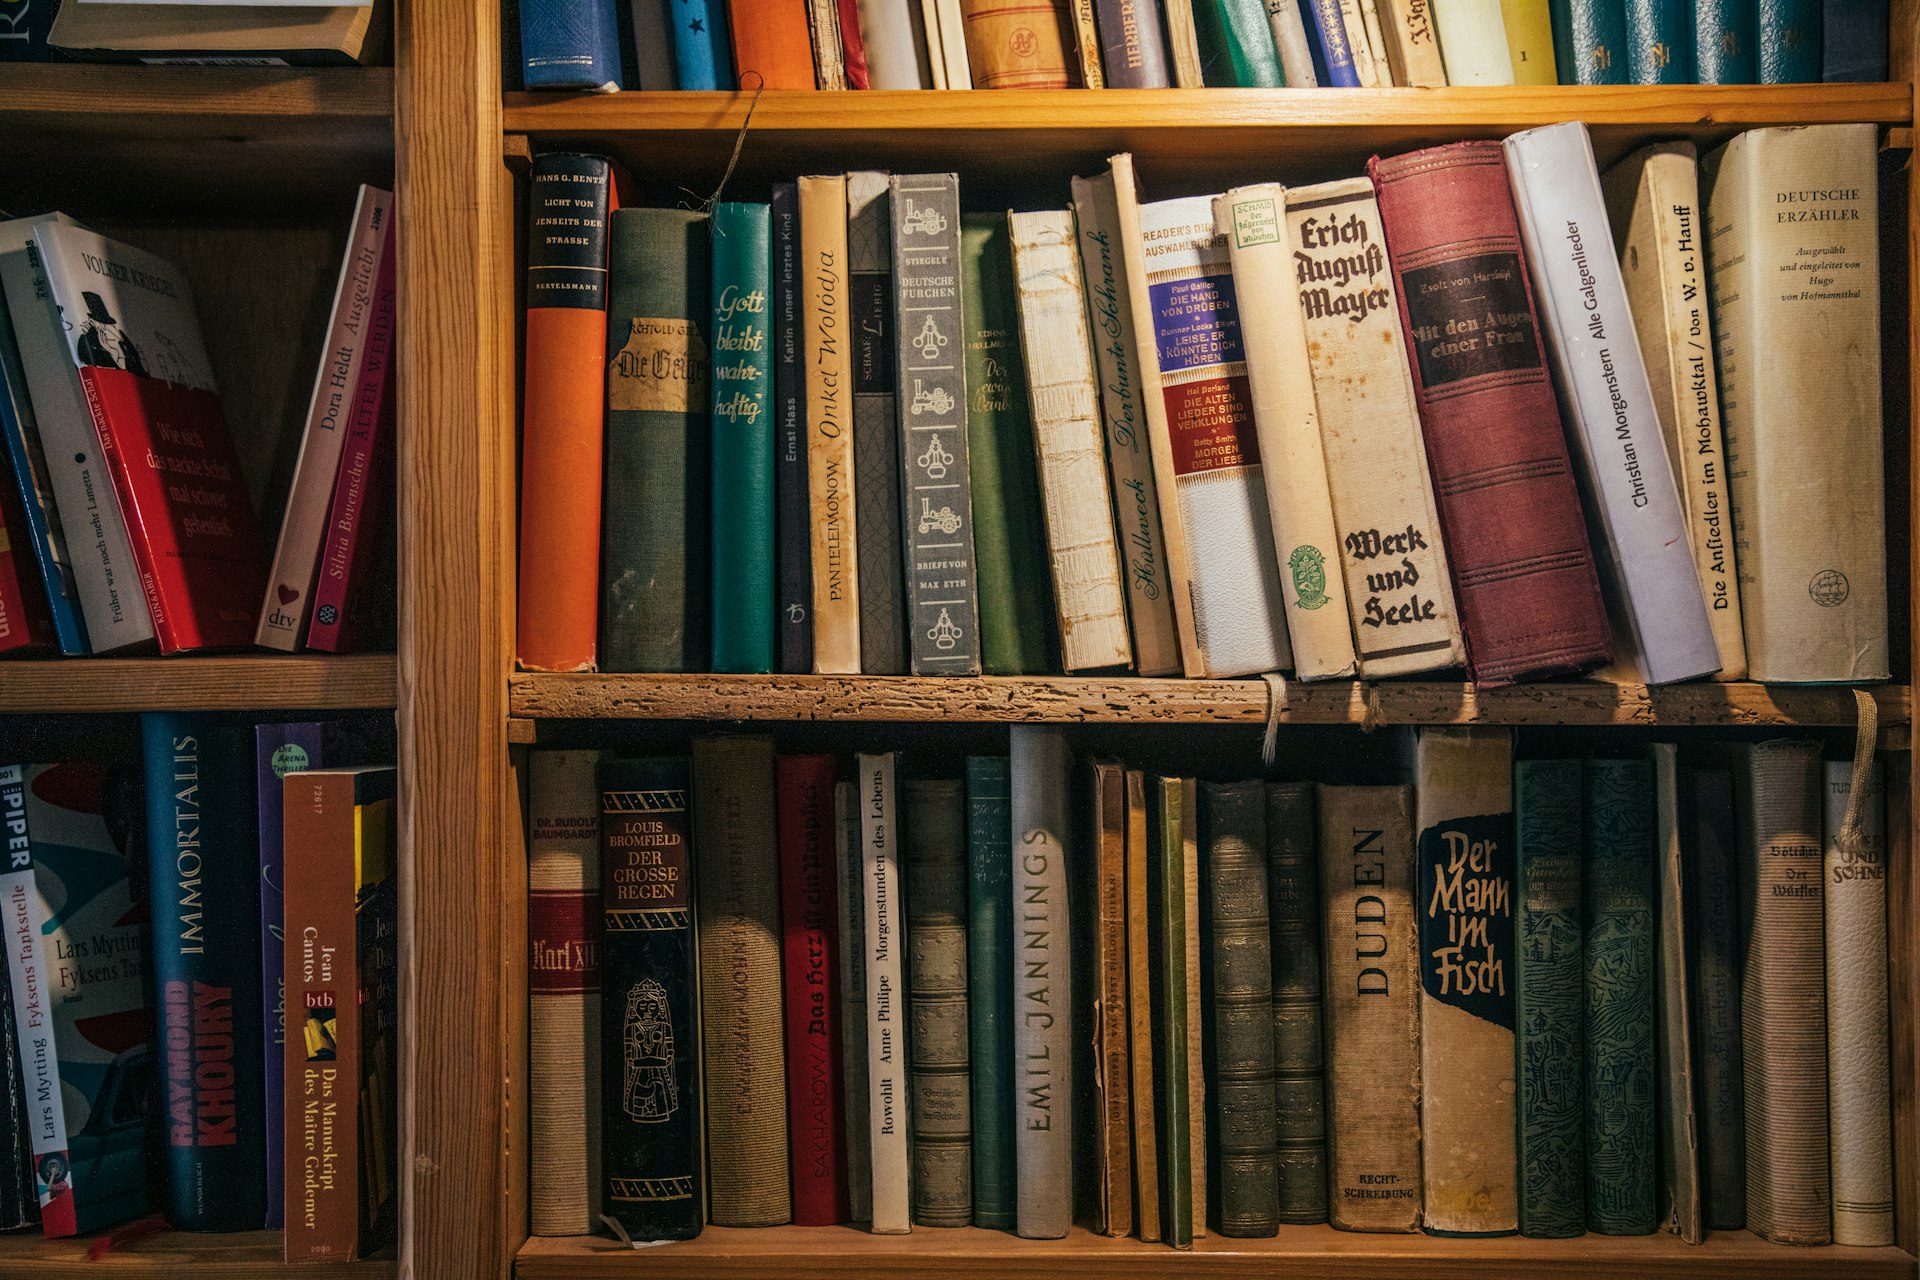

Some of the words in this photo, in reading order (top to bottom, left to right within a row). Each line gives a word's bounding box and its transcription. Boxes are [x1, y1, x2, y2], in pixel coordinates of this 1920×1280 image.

[572, 176, 605, 185] BENTZ
[544, 199, 572, 207] LICHT
[574, 199, 594, 208] VON
[1237, 201, 1273, 214] SCHMID
[1776, 189, 1861, 203] DEUTSCHE
[535, 218, 580, 227] JENSEITS
[583, 219, 603, 228] DER
[781, 213, 793, 244] Kind
[1300, 211, 1370, 250] Erich
[1673, 204, 1694, 252] Hauff
[1777, 209, 1861, 223] ERZÄHLER
[546, 236, 589, 246] STRASSE
[1143, 224, 1192, 243] READER'S
[26, 239, 40, 269] 23588
[782, 243, 793, 284] letztes
[904, 256, 948, 265] STIEGELE
[1294, 242, 1384, 288] August
[1566, 219, 1599, 312] Galgenlieder
[1779, 263, 1797, 272] und
[1799, 262, 1843, 272] eingeleitet
[1844, 261, 1861, 269] von
[1795, 246, 1846, 258] Ausgewählt
[82, 252, 131, 283] VOLKER
[902, 276, 954, 287] DEUTSCHE
[1809, 277, 1834, 287] Hugo
[343, 249, 376, 335] Ausgeliebt
[535, 282, 598, 292] BERTELSMANN
[902, 288, 955, 298] FURCHEN
[1088, 231, 1122, 339] Schrank
[1169, 295, 1189, 306] DIE
[1190, 291, 1220, 304] HAND
[1171, 284, 1190, 294] Paul
[1190, 281, 1215, 291] Gallico
[1420, 281, 1449, 294] Zsolt
[1450, 276, 1471, 288] von
[1682, 278, 1697, 302] W.
[1800, 290, 1861, 301] Hofmannsthal
[784, 287, 793, 326] unser
[1161, 306, 1185, 318] VON
[1300, 286, 1390, 323] Mayer
[368, 288, 395, 372] WERDEN
[715, 324, 764, 353] bleibt
[1160, 326, 1190, 337] Sumner
[1191, 323, 1214, 332] Locke
[1211, 331, 1226, 341] ER
[1411, 323, 1441, 344] Mit
[1445, 317, 1479, 335] den
[1587, 312, 1607, 340] Alle
[783, 327, 795, 364] Katrin
[1166, 344, 1209, 359] KÖNNTE
[1211, 341, 1236, 354] DICH
[1430, 336, 1479, 359] einer
[1484, 330, 1525, 347] Frau
[328, 346, 353, 391] Heldt
[618, 349, 648, 378] Die
[1107, 341, 1133, 401] bunte
[1184, 353, 1223, 366] HÖREN
[817, 369, 842, 439] Onkel
[1183, 396, 1203, 408] DIE
[1204, 393, 1237, 406] ALTEN
[1186, 386, 1201, 396] Hal
[1201, 383, 1231, 395] Borland
[1599, 347, 1632, 440] Morgenstern
[93, 404, 108, 431] nackte
[320, 394, 339, 433] Dora
[784, 397, 797, 433] Hass
[1177, 407, 1216, 421] LIEDER
[1218, 402, 1245, 415] SIND
[1688, 356, 1715, 456] Mohawktal
[156, 421, 181, 445] Wie
[1112, 402, 1140, 454] Der
[1176, 412, 1248, 431] VERKLUNGEN
[102, 430, 113, 450] Das
[785, 436, 797, 463] Ernst
[1193, 438, 1217, 448] Betty
[1216, 434, 1238, 445] Smith
[1194, 444, 1240, 459] MORGEN
[146, 447, 167, 471] das
[1191, 459, 1214, 470] DER
[1215, 454, 1245, 467] LIEBE
[1702, 460, 1714, 485] im
[1623, 441, 1648, 509] Christian
[83, 469, 98, 512] Lametta
[338, 450, 366, 537] Bovenschen
[89, 513, 105, 539] mehr
[827, 459, 842, 602] PANTELEIMONOW
[97, 539, 111, 566] noch
[1344, 524, 1429, 562] Werk
[329, 538, 348, 580] Silvia
[916, 560, 947, 571] BRIEFE
[947, 560, 967, 569] VON
[102, 567, 115, 588] war
[919, 580, 940, 589] MAX
[944, 579, 967, 589] EYTH
[1366, 556, 1421, 594] und
[107, 588, 124, 625] Früher
[1713, 581, 1728, 610] Die
[268, 607, 297, 629] dtv
[1361, 593, 1438, 629] Seele
[276, 754, 307, 763] ARENA
[313, 785, 323, 815] 72617
[870, 769, 884, 819] Lebens
[3, 792, 31, 869] PIPER
[609, 833, 682, 847] BROMFIELD
[624, 821, 664, 835] LOUIS
[875, 823, 886, 848] des
[172, 734, 205, 955] IMMORTALIS
[628, 851, 664, 866] DER
[1440, 829, 1500, 875] Der
[1841, 851, 1878, 864] UND
[613, 866, 680, 883] GROSSE
[617, 884, 676, 900] REGEN
[1428, 862, 1511, 920] Mann
[874, 853, 891, 963] Morgenstunden
[1353, 827, 1390, 998] DUDEN
[13, 883, 34, 965] Tankstelle
[1022, 829, 1055, 1031] JANNINGS
[1447, 912, 1490, 948] im
[55, 939, 89, 960] Lars
[303, 926, 318, 984] Cantos
[320, 944, 336, 983] Jean
[533, 938, 570, 972] Karl
[805, 935, 825, 986] Herz
[59, 963, 119, 991] Fyksens
[1431, 943, 1507, 998] Fisch
[22, 964, 40, 1030] Fyksens
[304, 992, 334, 1008] btb
[876, 974, 893, 1023] Philipe
[808, 992, 826, 1036] Das
[878, 1028, 893, 1065] Anne
[35, 1037, 55, 1103] Mytting
[164, 979, 194, 1148] RAYMOND
[193, 980, 238, 1147] KHOURY
[1110, 1050, 1121, 1088] PIEPER
[304, 1067, 318, 1097] des
[322, 1067, 337, 1092] Das
[1024, 1044, 1053, 1133] EMIL
[811, 1054, 831, 1179] SAKHAROW
[880, 1078, 895, 1136] Rowohlt
[43, 1106, 56, 1141] Lars
[304, 1100, 319, 1152] Maître
[321, 1095, 338, 1192] Manuskript
[303, 1156, 320, 1230] Godemer
[1343, 1187, 1415, 1199] SCHREIBUNG
[1359, 1174, 1401, 1186] RECHT-
